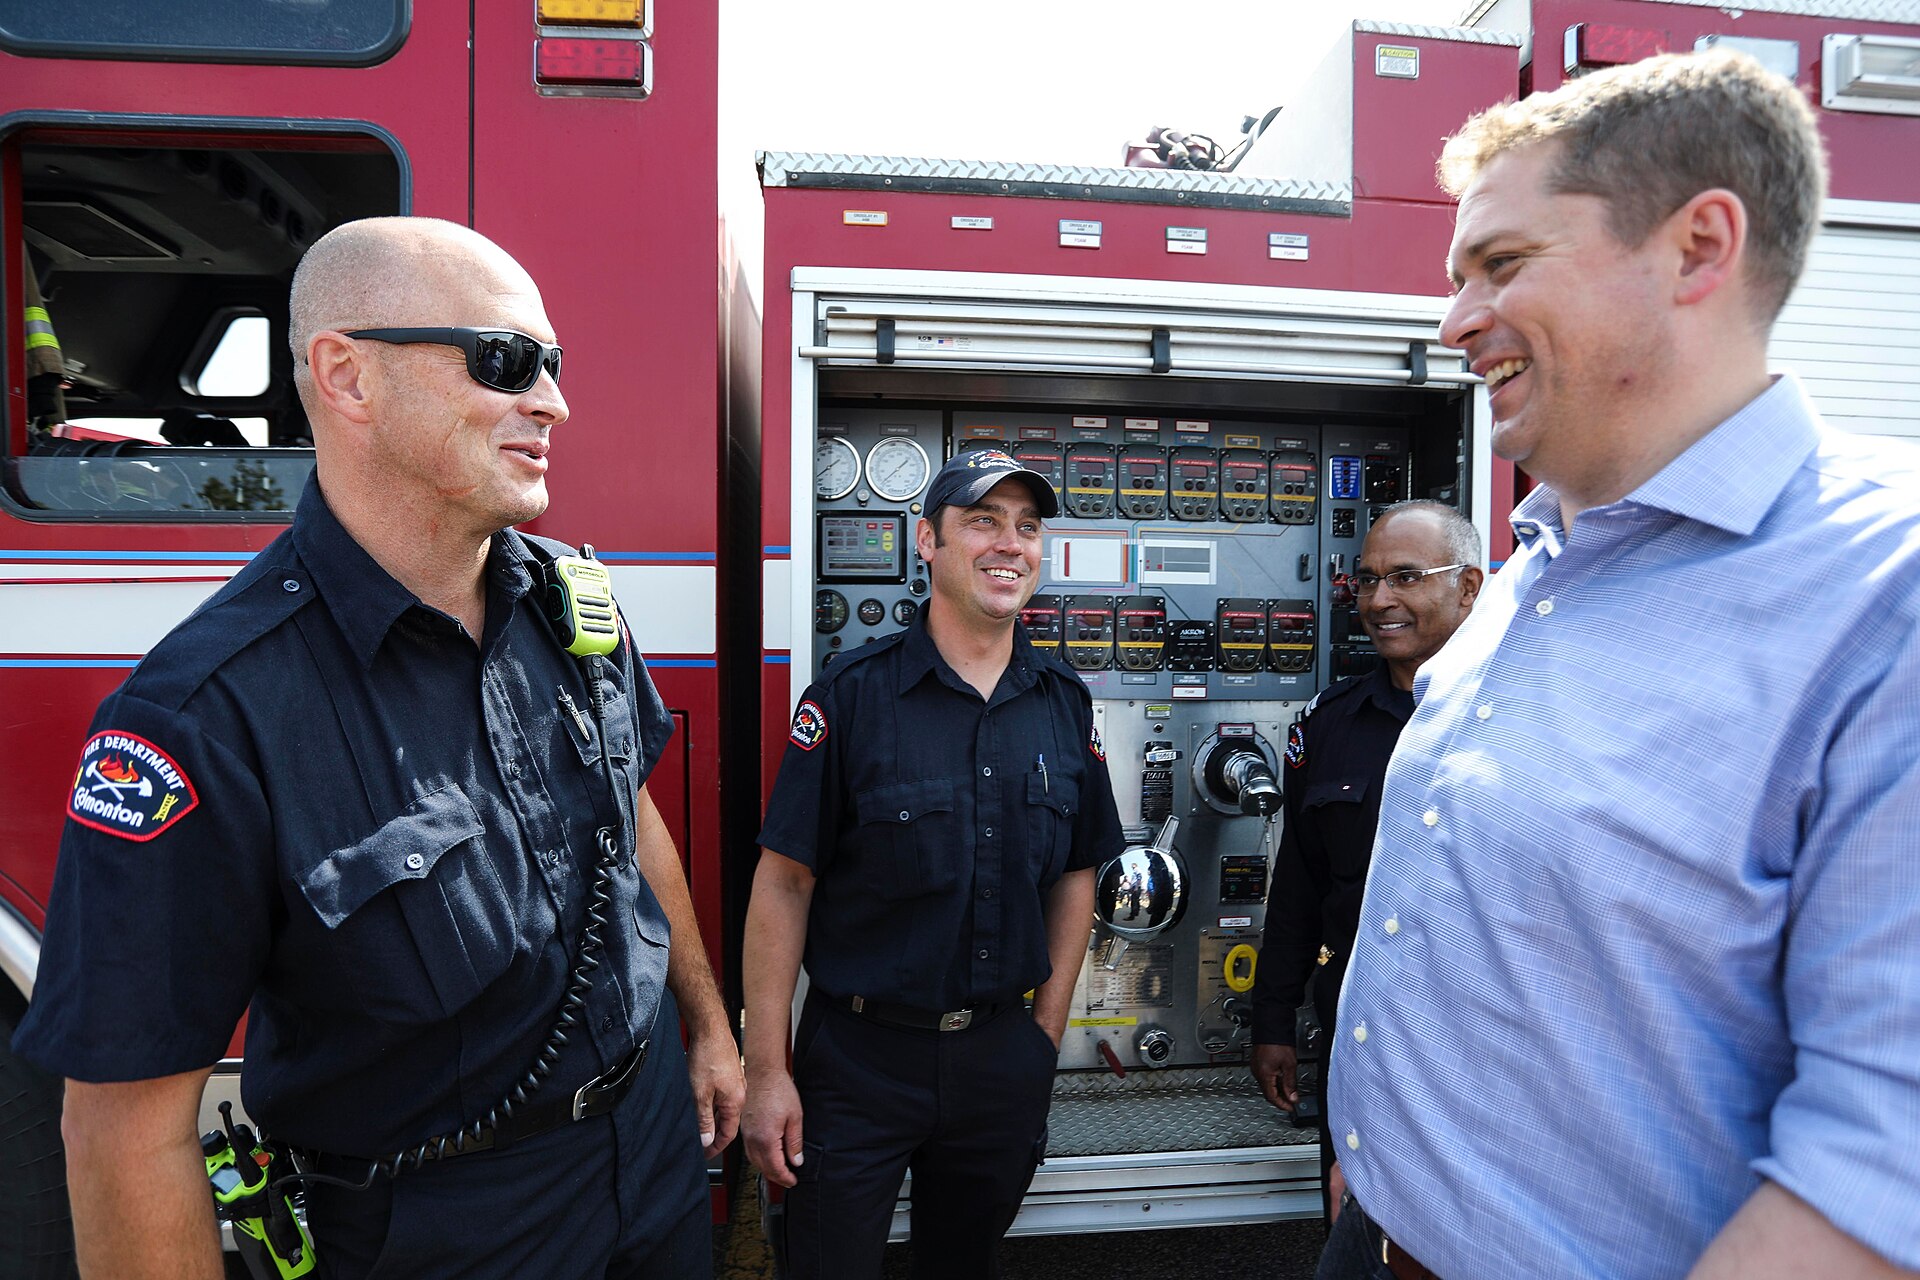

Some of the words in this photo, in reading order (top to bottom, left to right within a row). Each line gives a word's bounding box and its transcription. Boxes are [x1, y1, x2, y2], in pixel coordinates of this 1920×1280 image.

[84, 738, 101, 761] FIRE
[104, 735, 185, 790] DEPARTMENT
[73, 786, 145, 828] Edmonton
